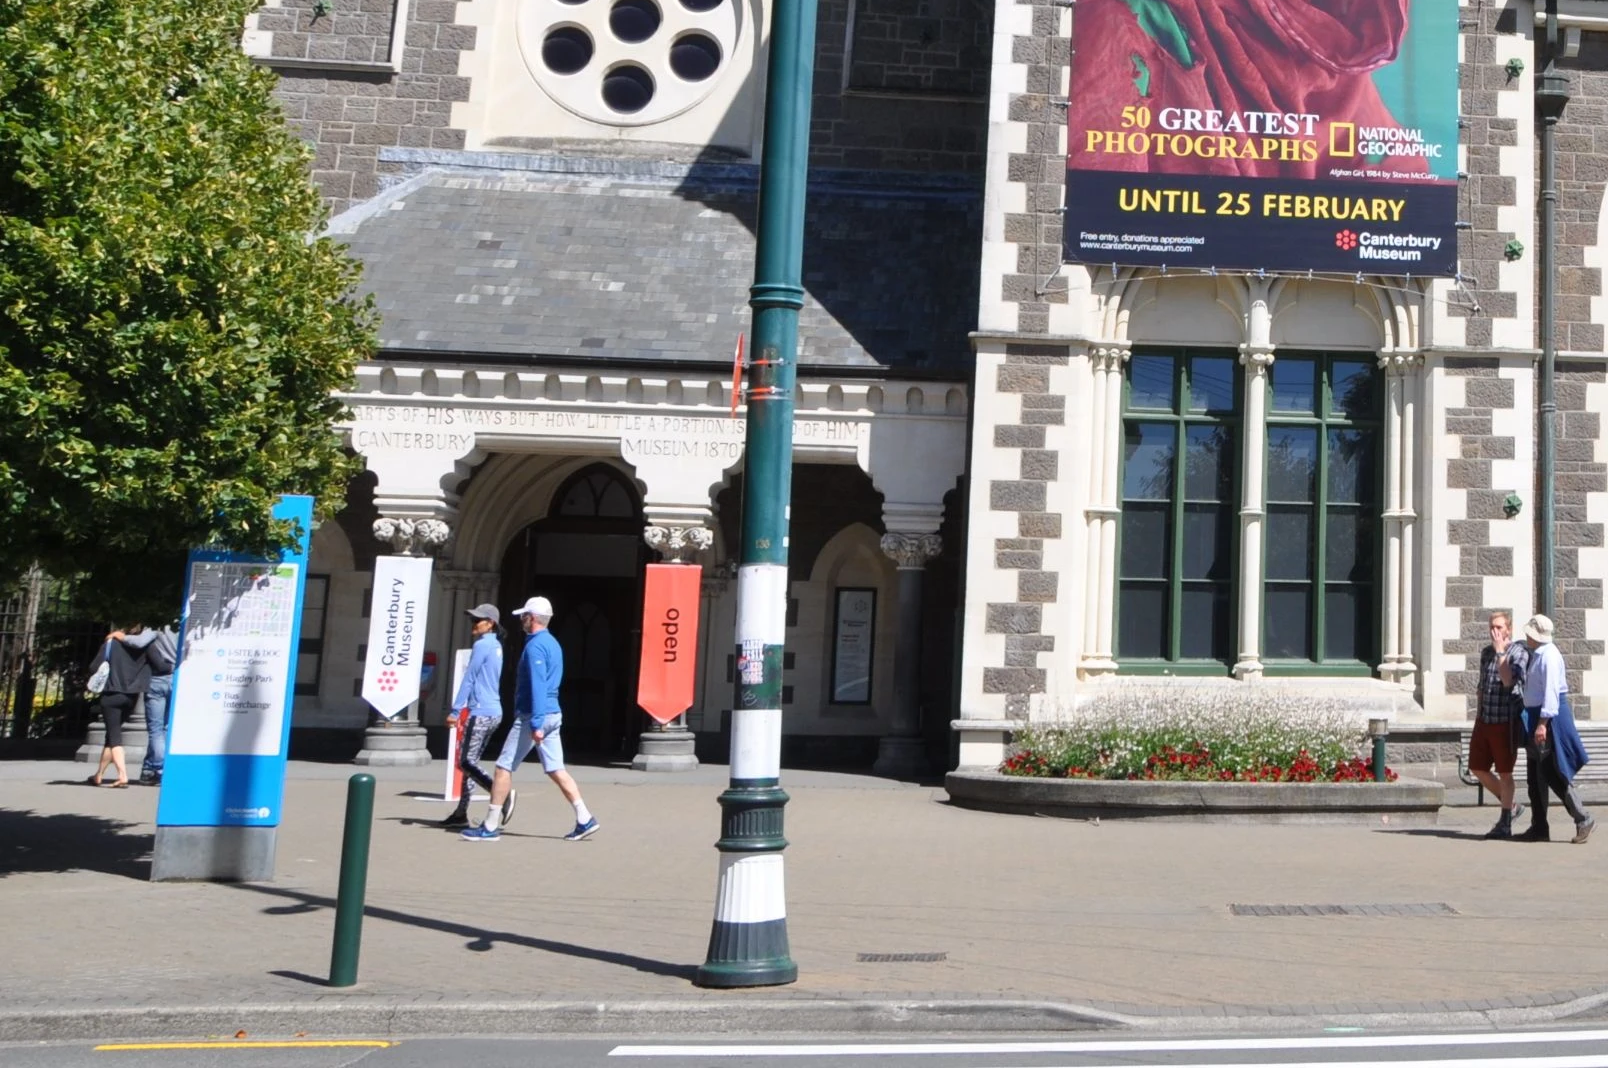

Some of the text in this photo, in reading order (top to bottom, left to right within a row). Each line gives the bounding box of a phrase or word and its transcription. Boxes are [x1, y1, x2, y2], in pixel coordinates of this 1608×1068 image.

[1120, 106, 1320, 136] 50 GREATEST
[1359, 126, 1424, 143] NATIONAL
[1085, 130, 1319, 163] PHOTOGRAPHS
[1358, 141, 1442, 158] GEOGRAPHIC
[1329, 168, 1352, 177] Afghan
[1382, 171, 1391, 180] by
[1392, 171, 1409, 179] Steve
[1411, 172, 1439, 181] McCurry
[1119, 188, 1406, 221] UNTIL 25 FEBRUARY
[1080, 231, 1098, 240] Free
[1121, 234, 1159, 243] donations
[1160, 236, 1204, 245] appreciated
[1080, 241, 1192, 252] www.canterburymuseum.com
[1359, 231, 1441, 250] Canterbury
[1359, 246, 1421, 261] Museum
[403, 407, 417, 422] OF
[427, 407, 455, 425] HIS
[462, 409, 502, 426] WAYS
[509, 411, 539, 427] BUT
[587, 414, 641, 431] LITTLE
[663, 418, 726, 434] PORTION
[804, 422, 820, 437] OF
[358, 431, 738, 459] CANTERBURY MUSEUM 1870
[382, 578, 404, 666] Canterbury
[396, 600, 415, 666] Museum
[661, 608, 680, 663] open
[225, 674, 273, 684] Hagley Park
[223, 701, 272, 710] Interchange
